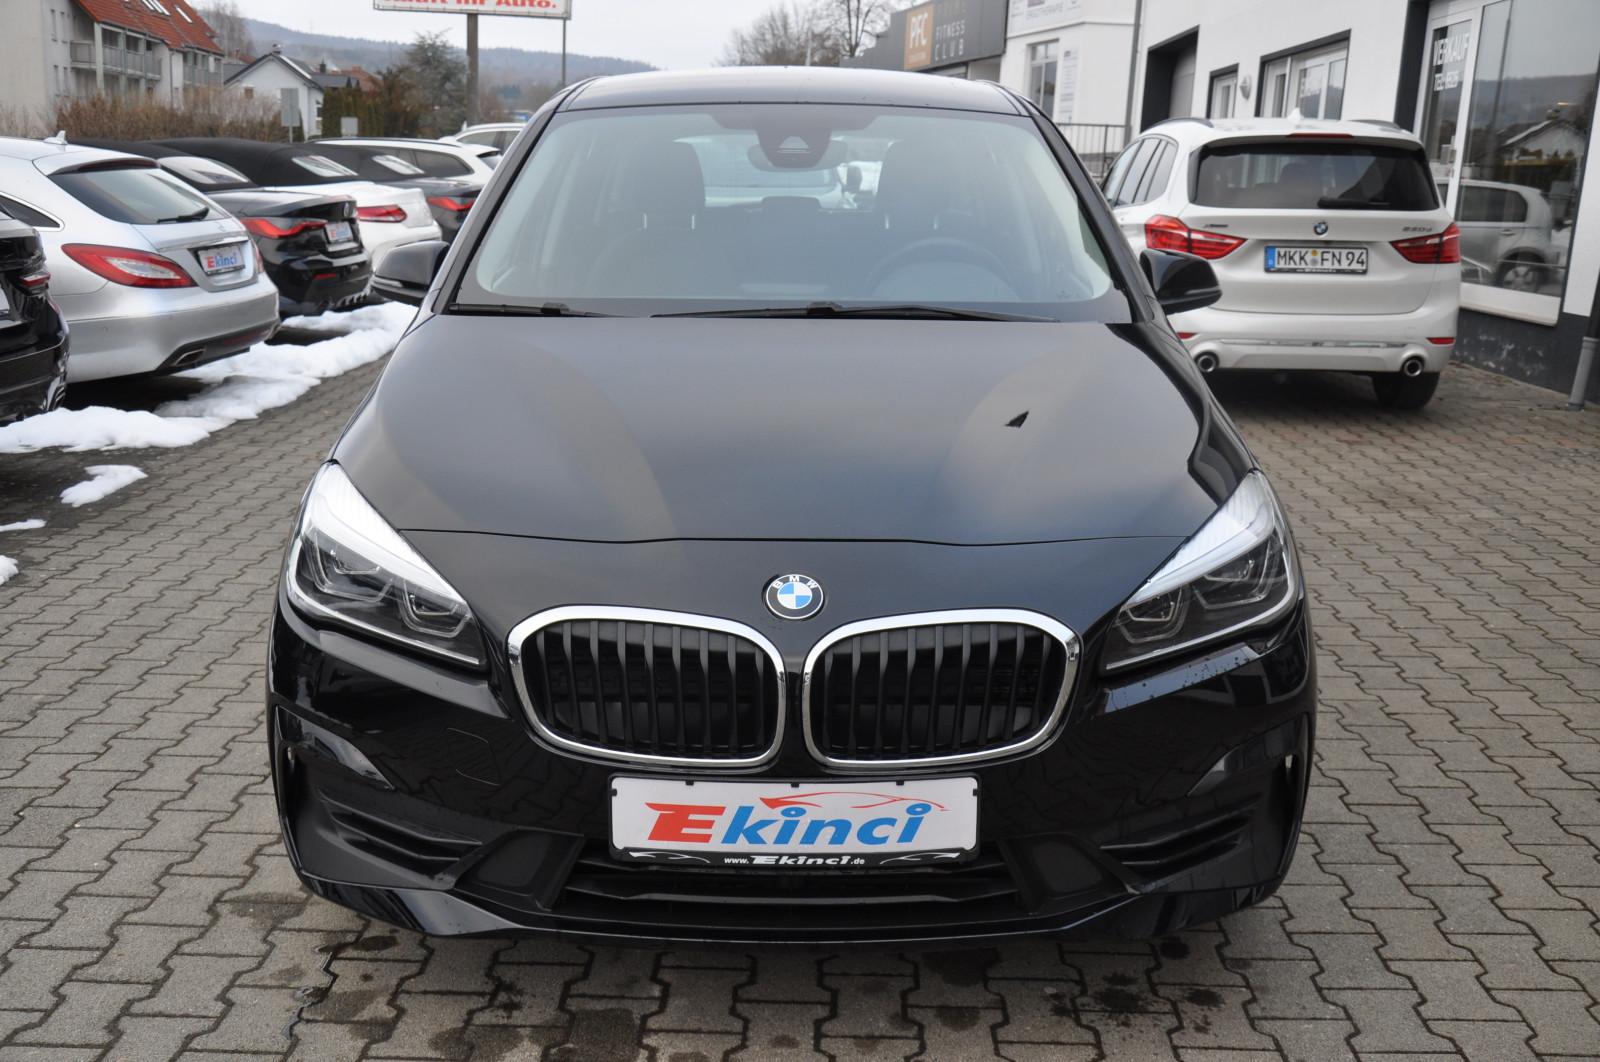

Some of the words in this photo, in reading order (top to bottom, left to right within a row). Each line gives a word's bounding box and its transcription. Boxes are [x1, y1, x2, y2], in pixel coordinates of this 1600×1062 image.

[910, 12, 928, 48] PFC
[935, 20, 966, 40] FITNESS
[935, 38, 964, 61] CLUB
[204, 252, 238, 269] Ekinci
[1277, 250, 1309, 266] MKK
[1320, 250, 1342, 266] FN
[1345, 251, 1365, 267] 94
[644, 801, 932, 846] Ekinci
[724, 855, 866, 865] www.Ekinci.de
